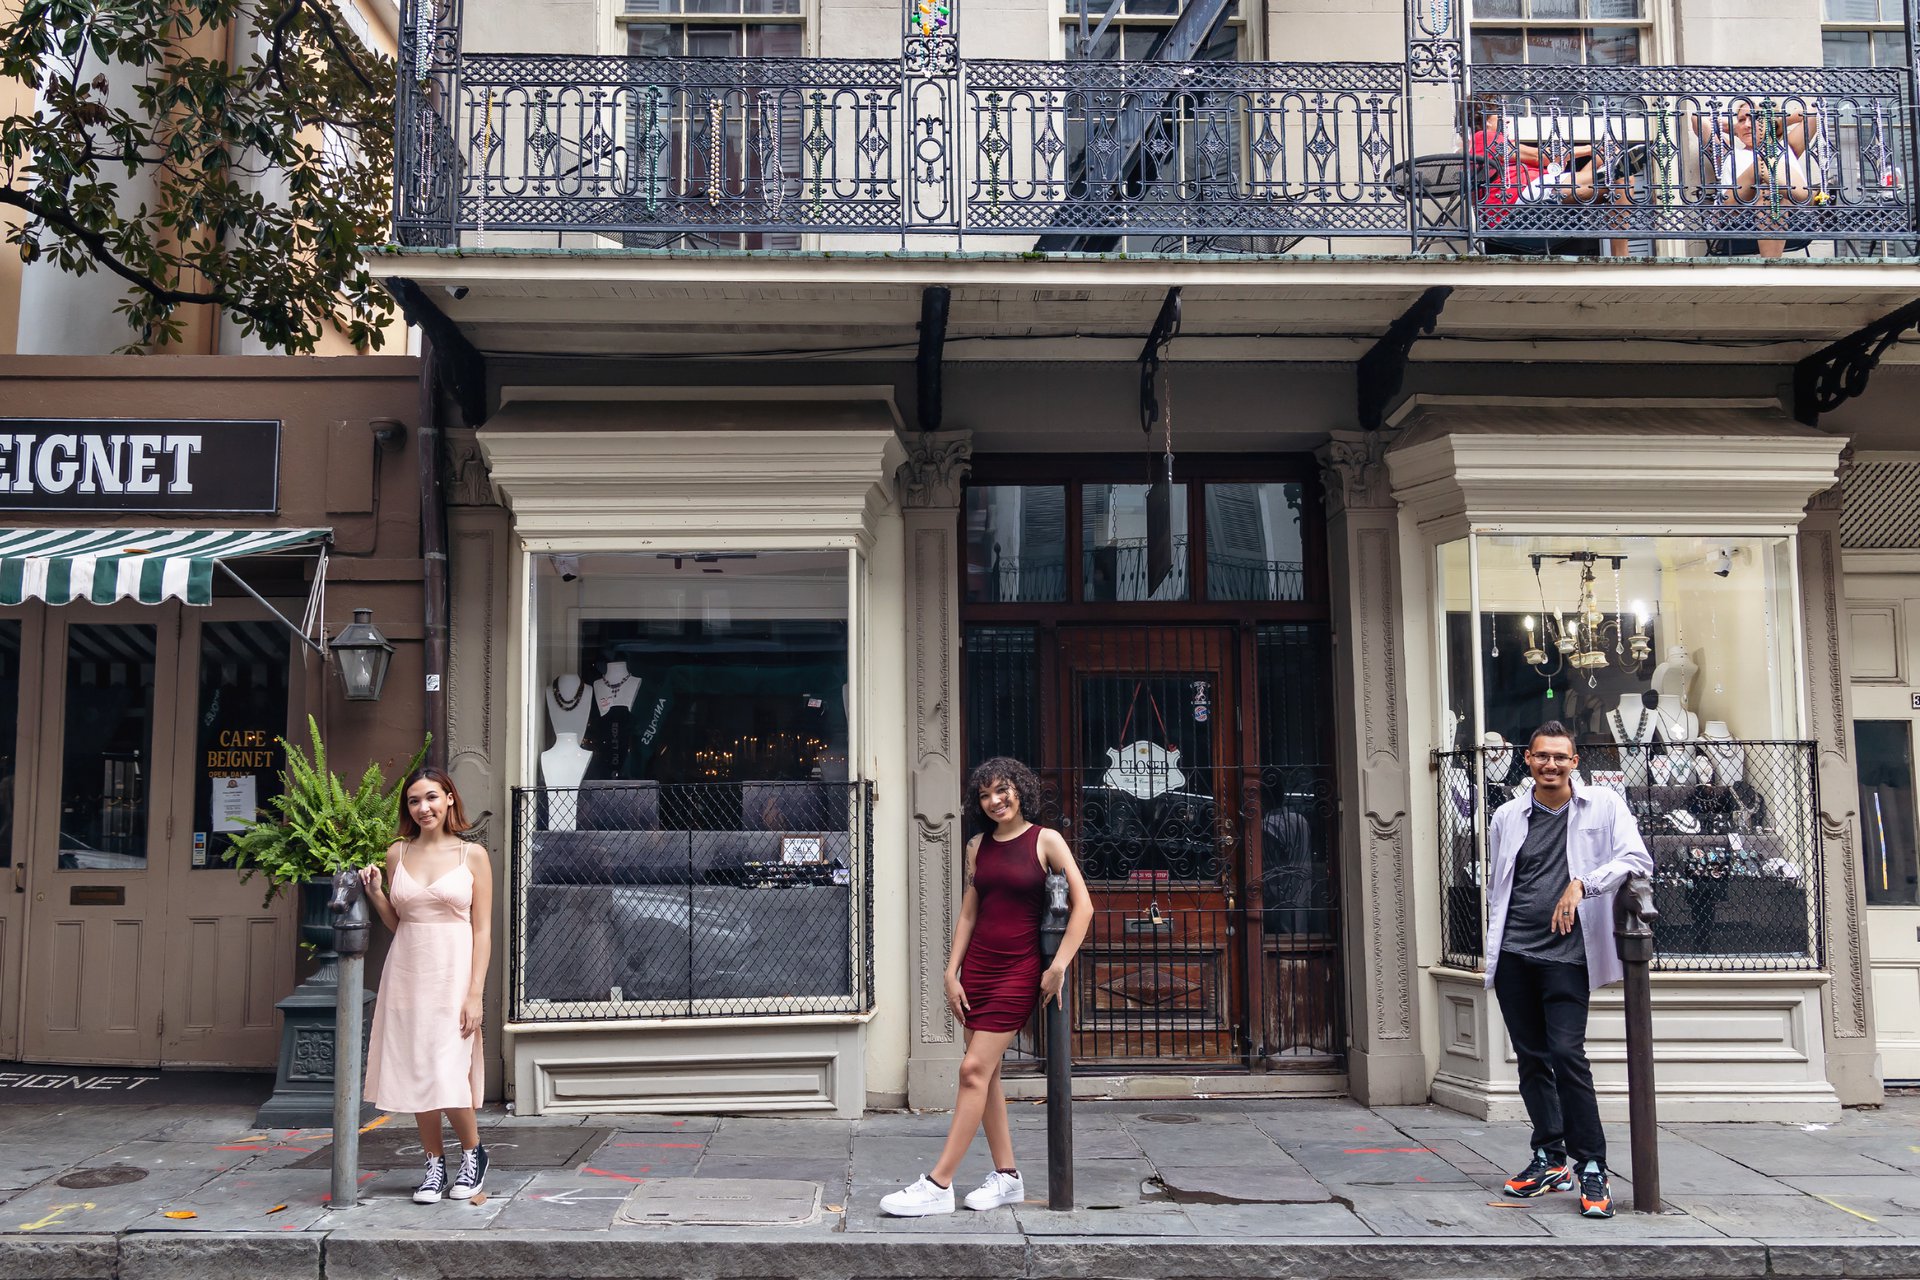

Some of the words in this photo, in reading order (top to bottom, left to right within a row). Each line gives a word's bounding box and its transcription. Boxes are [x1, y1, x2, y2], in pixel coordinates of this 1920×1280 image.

[219, 729, 266, 748] CAFE
[207, 751, 274, 768] BEIGNET
[1120, 760, 1169, 774] CLOSED
